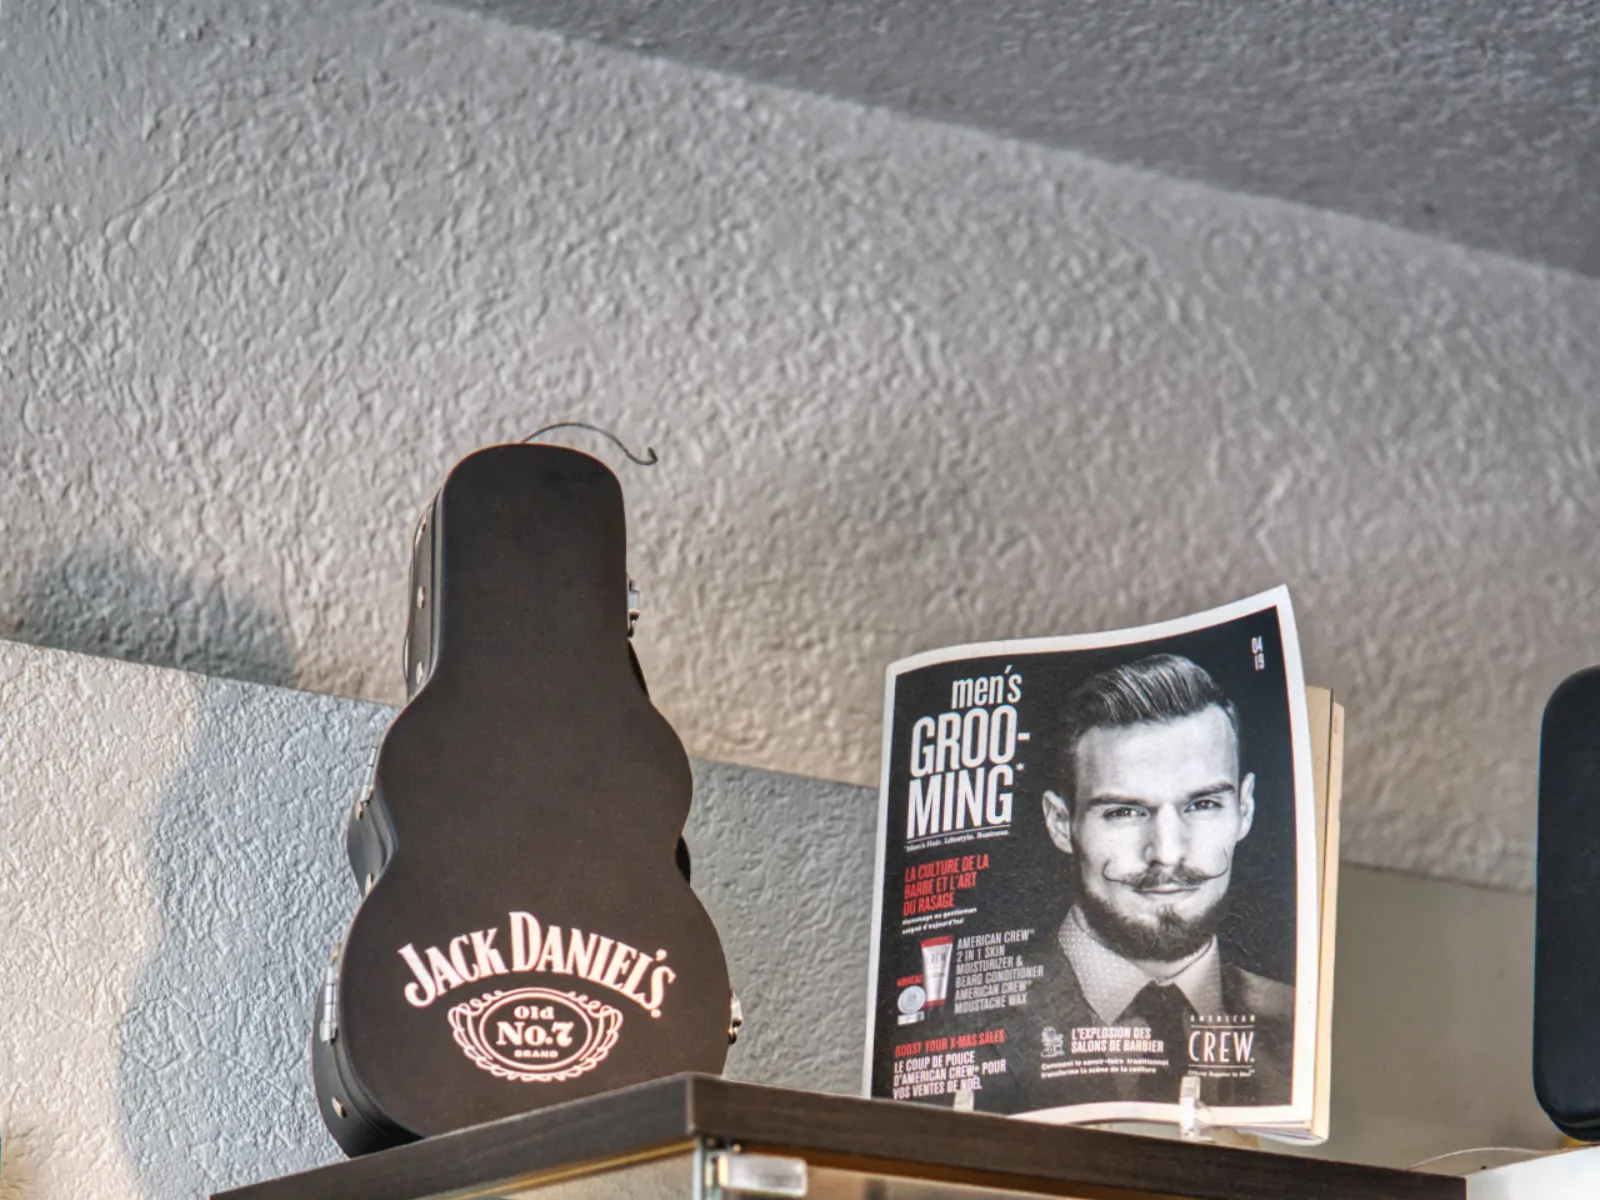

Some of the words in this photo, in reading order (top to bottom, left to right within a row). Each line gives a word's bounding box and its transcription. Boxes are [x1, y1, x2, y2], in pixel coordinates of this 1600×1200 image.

[1254, 653, 1265, 671] 19
[951, 665, 1022, 709] men's
[910, 705, 1031, 778] GROO-
[904, 867, 916, 883] LA
[917, 857, 960, 880] CULTURE
[961, 855, 975, 871] DE
[976, 853, 989, 870] LA
[904, 879, 934, 900] BARBE
[935, 876, 948, 893] ET
[949, 871, 977, 891] L'ART
[903, 899, 916, 917] DU
[918, 891, 955, 913] RASAGE
[956, 932, 1002, 950] AMERICAN
[398, 927, 509, 1008] JACK
[508, 911, 677, 1013] DANIEL'S
[956, 951, 963, 963] 2
[964, 949, 974, 961] IN
[984, 945, 1005, 959] SKIN
[956, 956, 1014, 976] MOISTURIZER
[1015, 955, 1023, 967] &
[955, 974, 983, 988] BEARD
[985, 965, 1044, 983] CONDITIONER
[955, 984, 999, 1002] AMERICAN
[513, 1004, 555, 1021] Old
[954, 996, 1006, 1014] MOUSTACHE
[1189, 1014, 1256, 1023] AMERICAN
[895, 1042, 922, 1058] BOOST
[924, 1037, 948, 1053] YOUR
[950, 1034, 977, 1049] X-MAS
[979, 1028, 1005, 1046] SALES
[1071, 1027, 1131, 1040] L'EXPLOSION
[1133, 1027, 1151, 1039] DES
[513, 1049, 559, 1060] BRAND
[1071, 1040, 1106, 1053] SALONS
[1109, 1040, 1121, 1052] DE
[1123, 1040, 1164, 1053] BARBIER
[894, 1060, 904, 1074] LE
[905, 1056, 930, 1072] COUP
[932, 1054, 943, 1068] DE
[945, 1050, 976, 1066] POUCE
[893, 1068, 947, 1087] D'AMERICAN
[982, 1059, 1006, 1075] POUR
[893, 1086, 910, 1100] VOS
[912, 1081, 945, 1097] VENTES
[947, 1080, 958, 1093] DE
